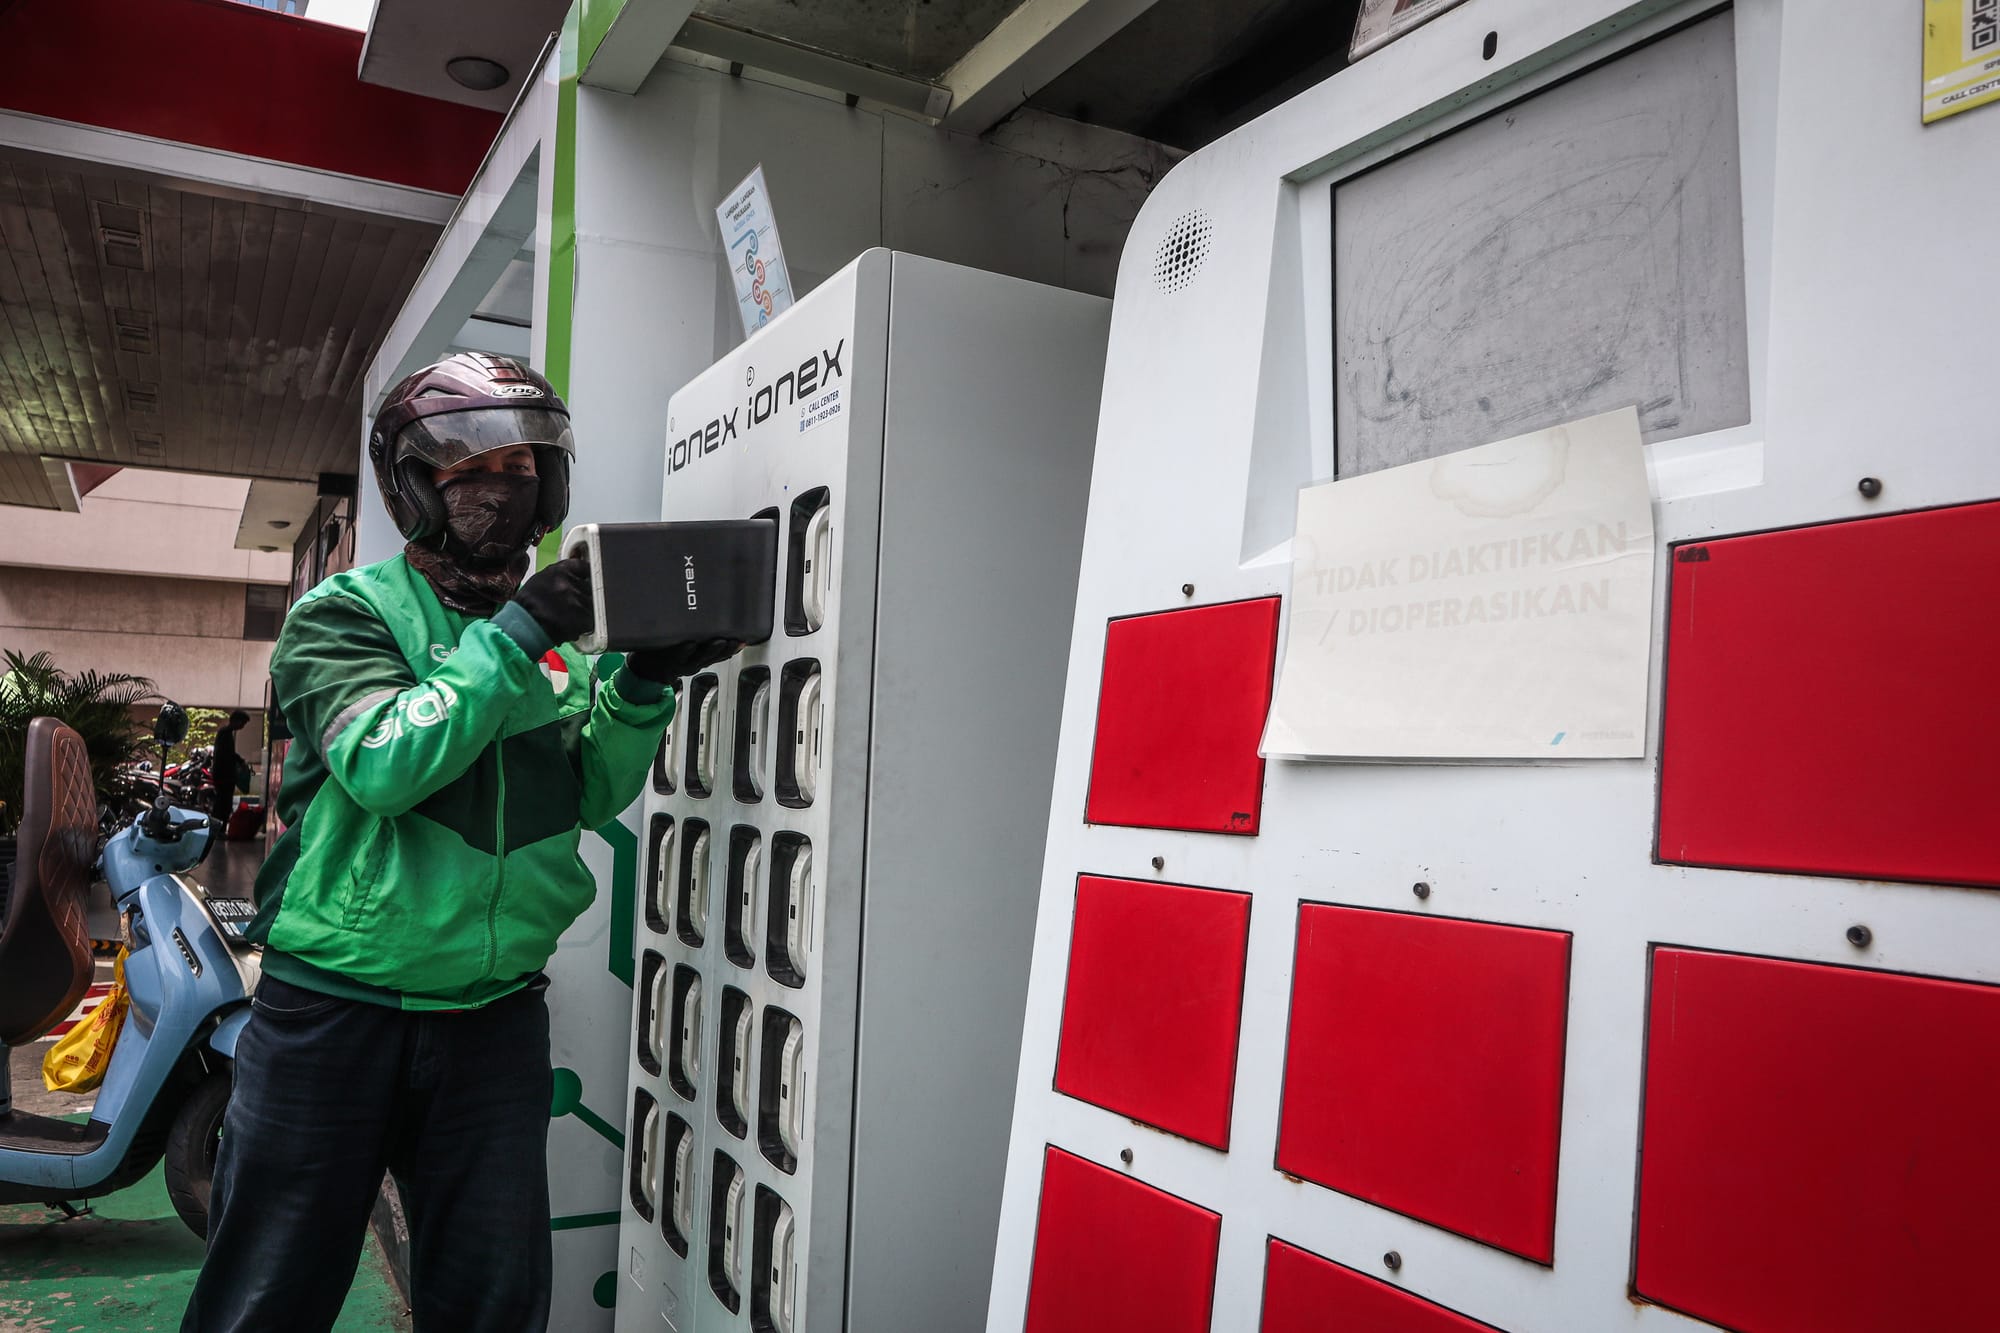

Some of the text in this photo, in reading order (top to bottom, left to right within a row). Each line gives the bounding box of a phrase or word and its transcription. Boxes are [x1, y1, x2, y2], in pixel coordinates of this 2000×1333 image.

[1942, 91, 1969, 104] CALL
[747, 338, 844, 430] ionex
[808, 389, 839, 413] CALL CENTER
[668, 406, 739, 475] ionex
[684, 555, 697, 610] ionex
[1313, 521, 1626, 595] TIDAK DIAKTIFKAN
[1318, 578, 1610, 646] / DIOPERASIKAN
